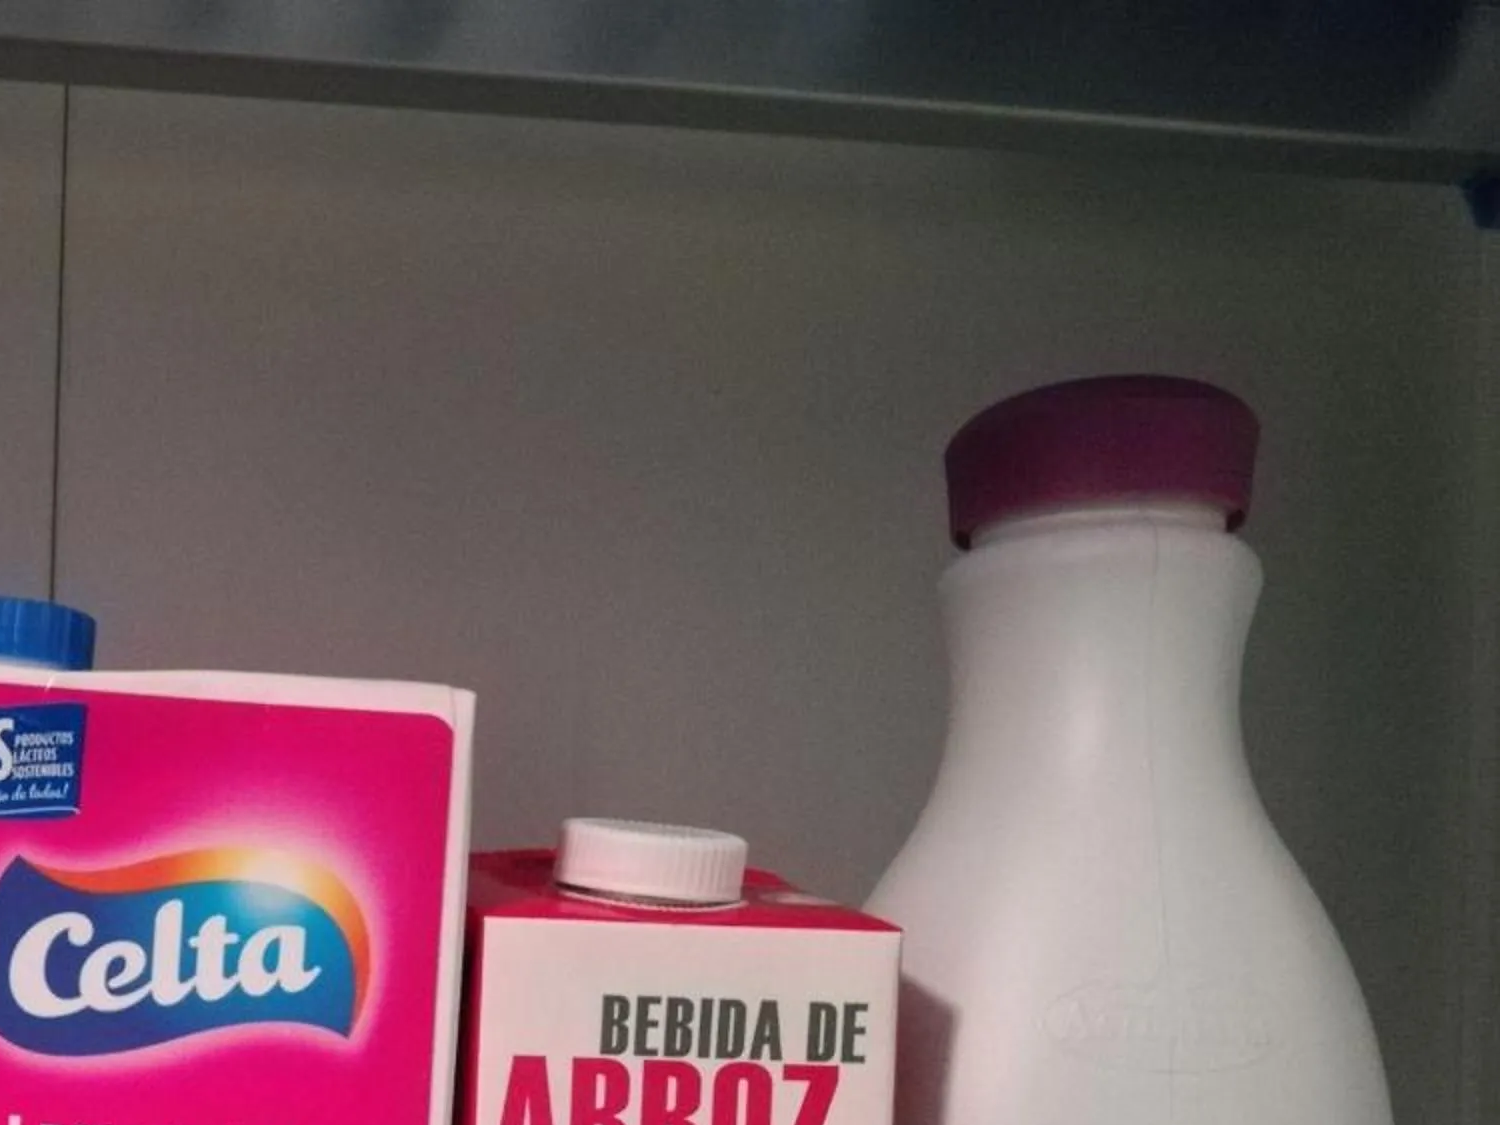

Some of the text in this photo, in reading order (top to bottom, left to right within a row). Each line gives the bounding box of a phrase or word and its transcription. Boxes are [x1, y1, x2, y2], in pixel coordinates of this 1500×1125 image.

[14, 731, 74, 747] PRODUCTOS
[12, 763, 75, 780] SOSTENIBLES
[8, 899, 322, 1018] Celta
[600, 994, 869, 1064] BEBIDA DE
